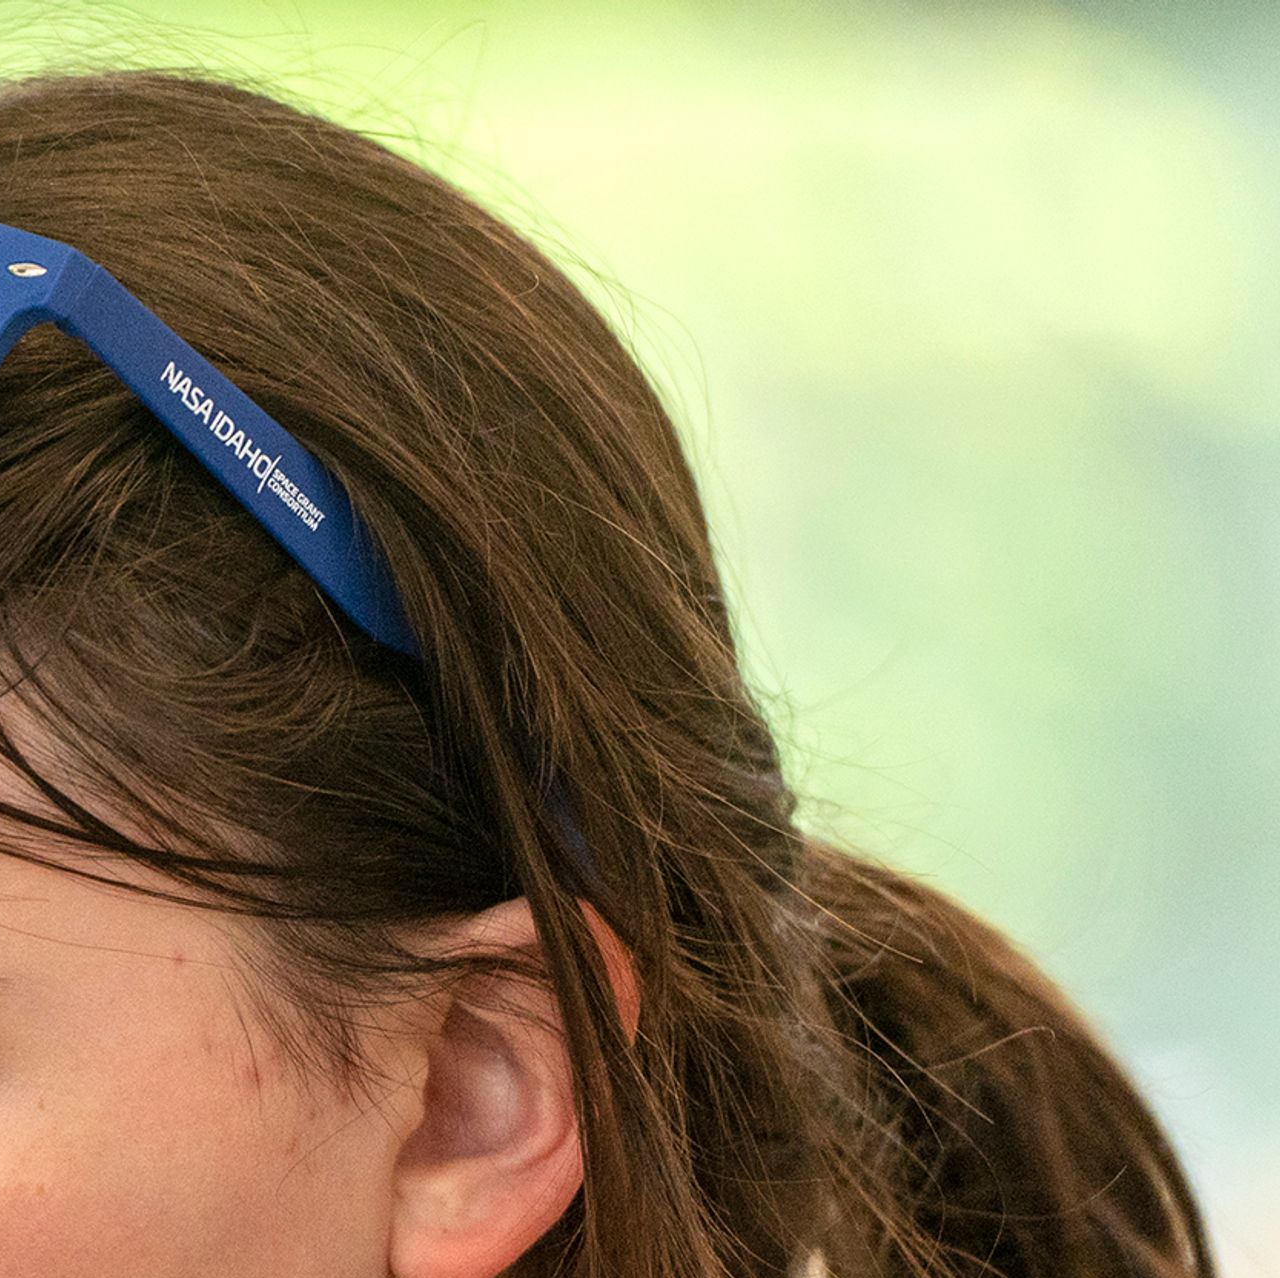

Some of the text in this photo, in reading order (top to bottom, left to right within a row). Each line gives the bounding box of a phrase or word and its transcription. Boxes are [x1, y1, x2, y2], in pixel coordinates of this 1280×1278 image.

[160, 361, 271, 480] NASA IDAHO
[267, 480, 320, 532] CONSORTIUM
[272, 468, 325, 522] SPACE GRANT
